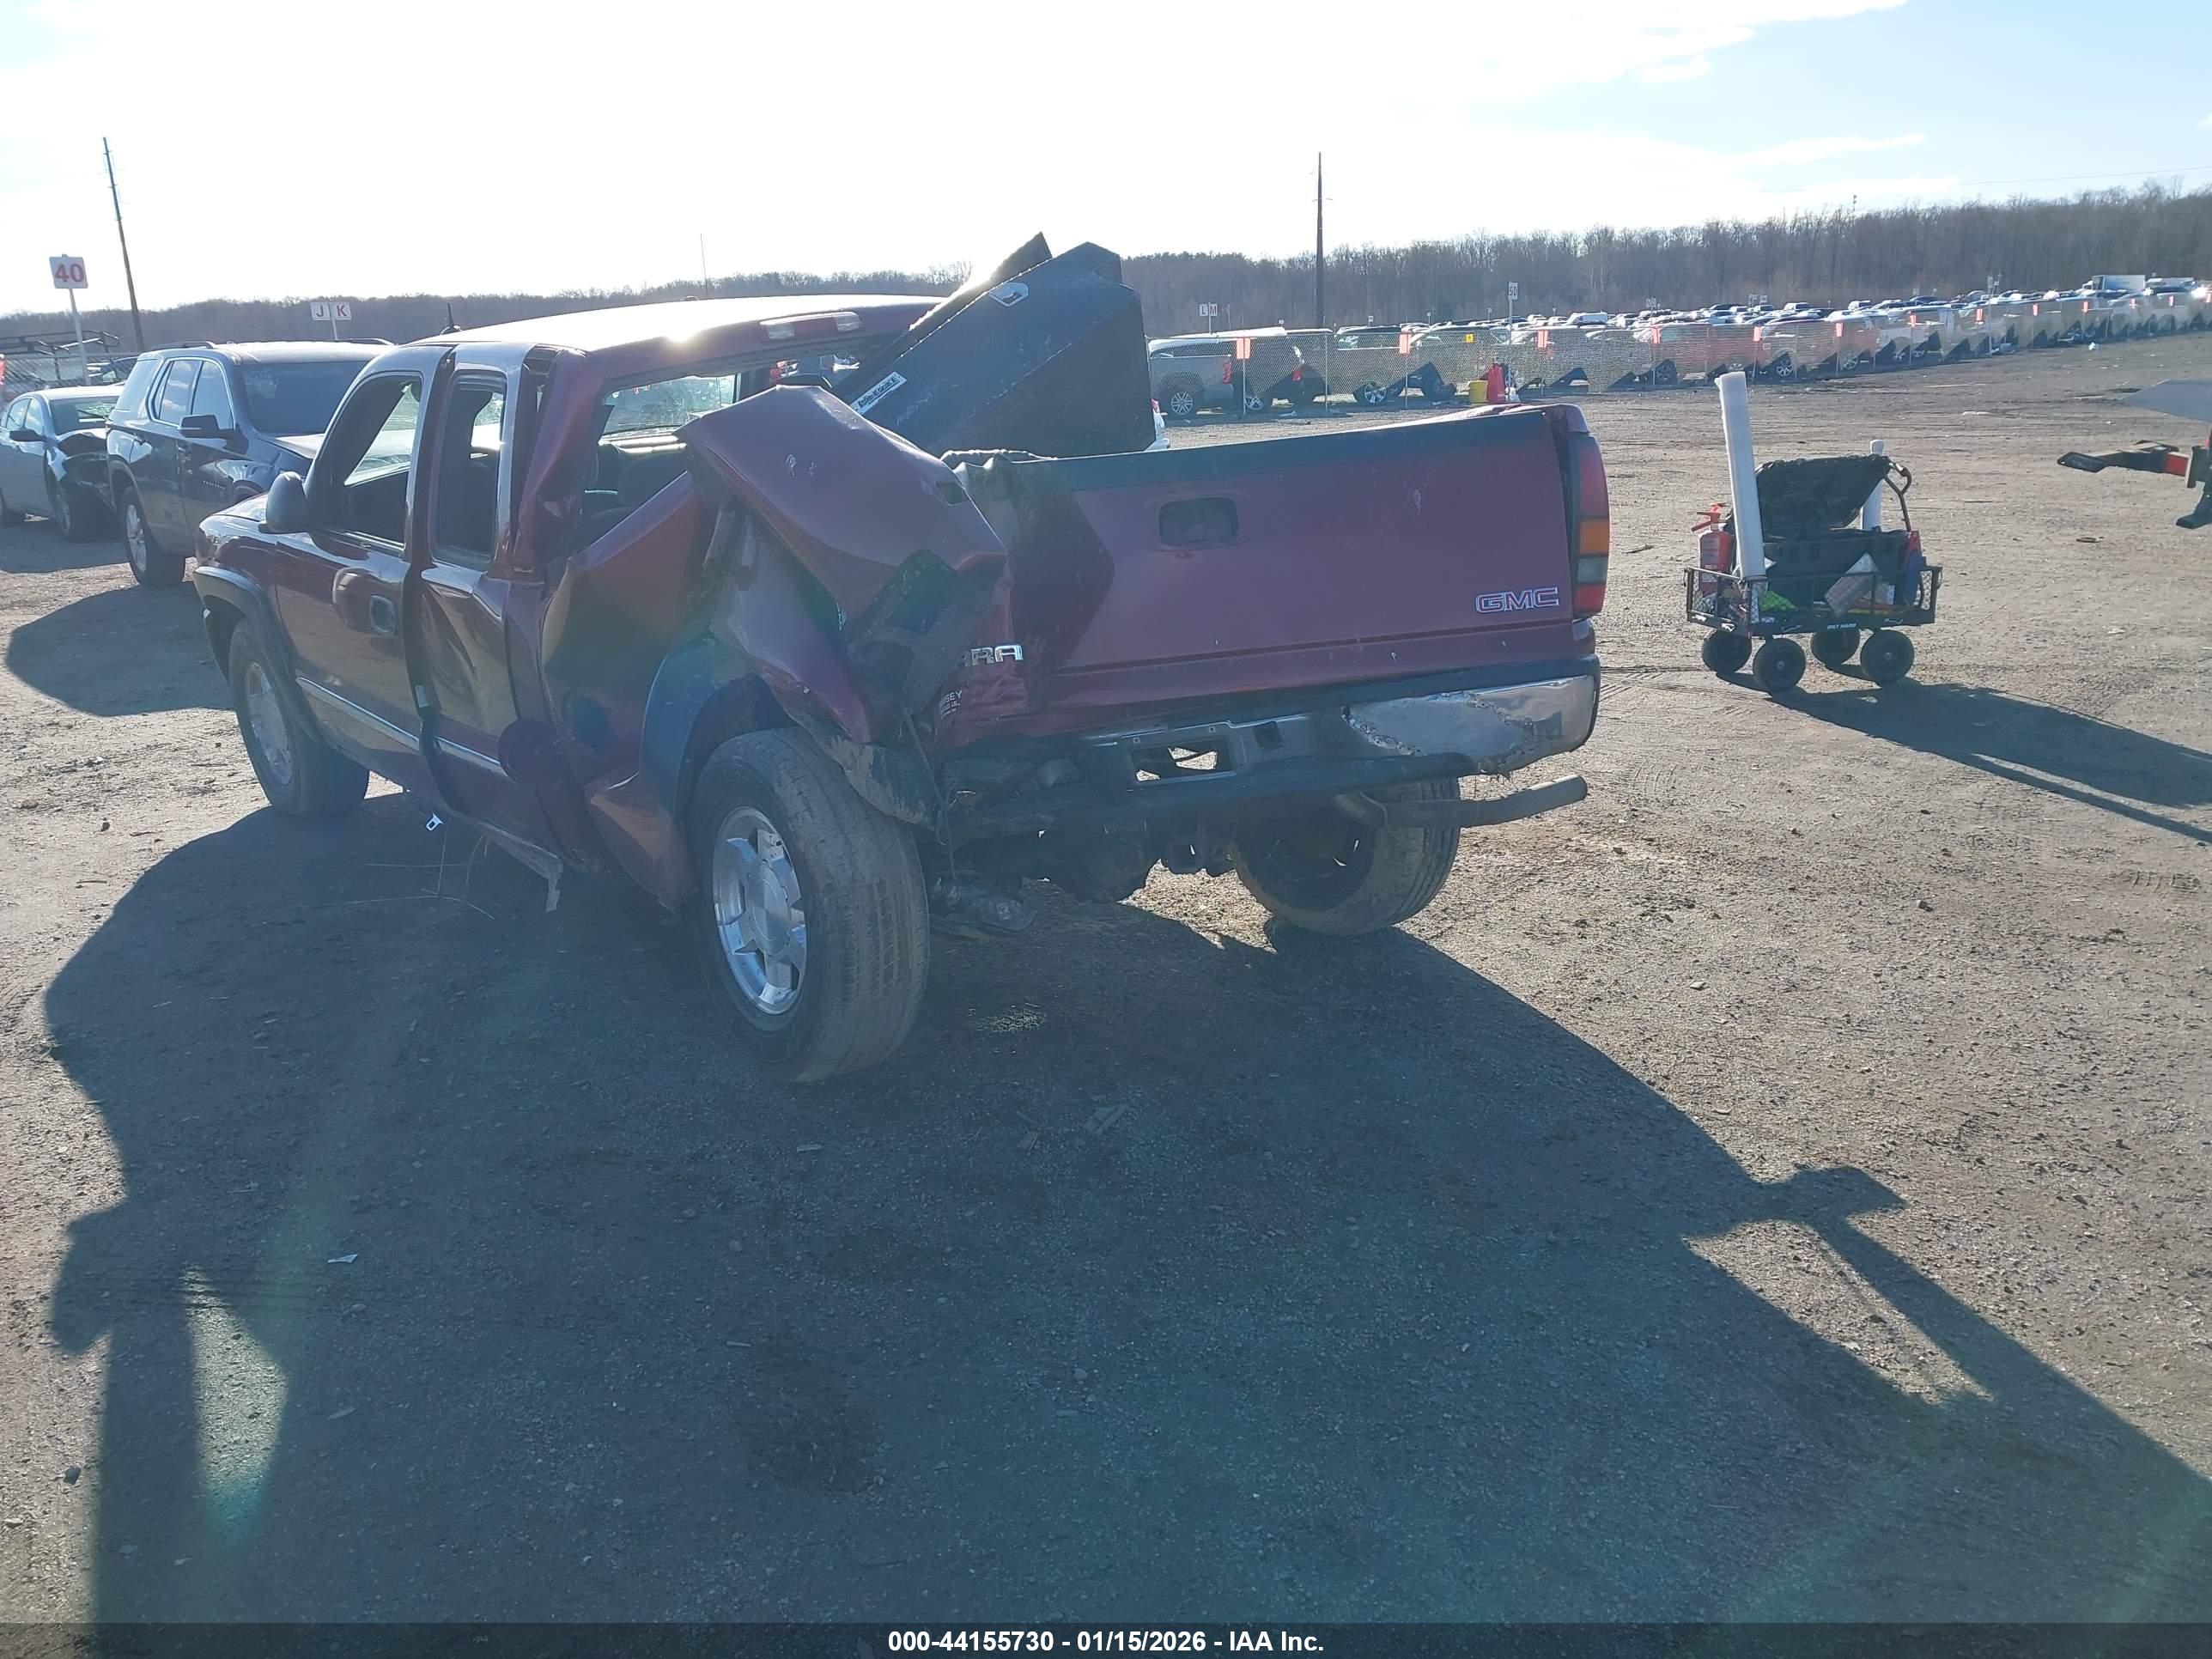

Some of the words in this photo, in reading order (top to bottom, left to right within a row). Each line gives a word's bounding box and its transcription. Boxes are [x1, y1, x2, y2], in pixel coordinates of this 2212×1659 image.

[55, 264, 84, 283] 40
[1509, 286, 1517, 296] 50
[316, 305, 324, 318] J
[336, 305, 348, 317] K
[1476, 586, 1559, 613] GMC
